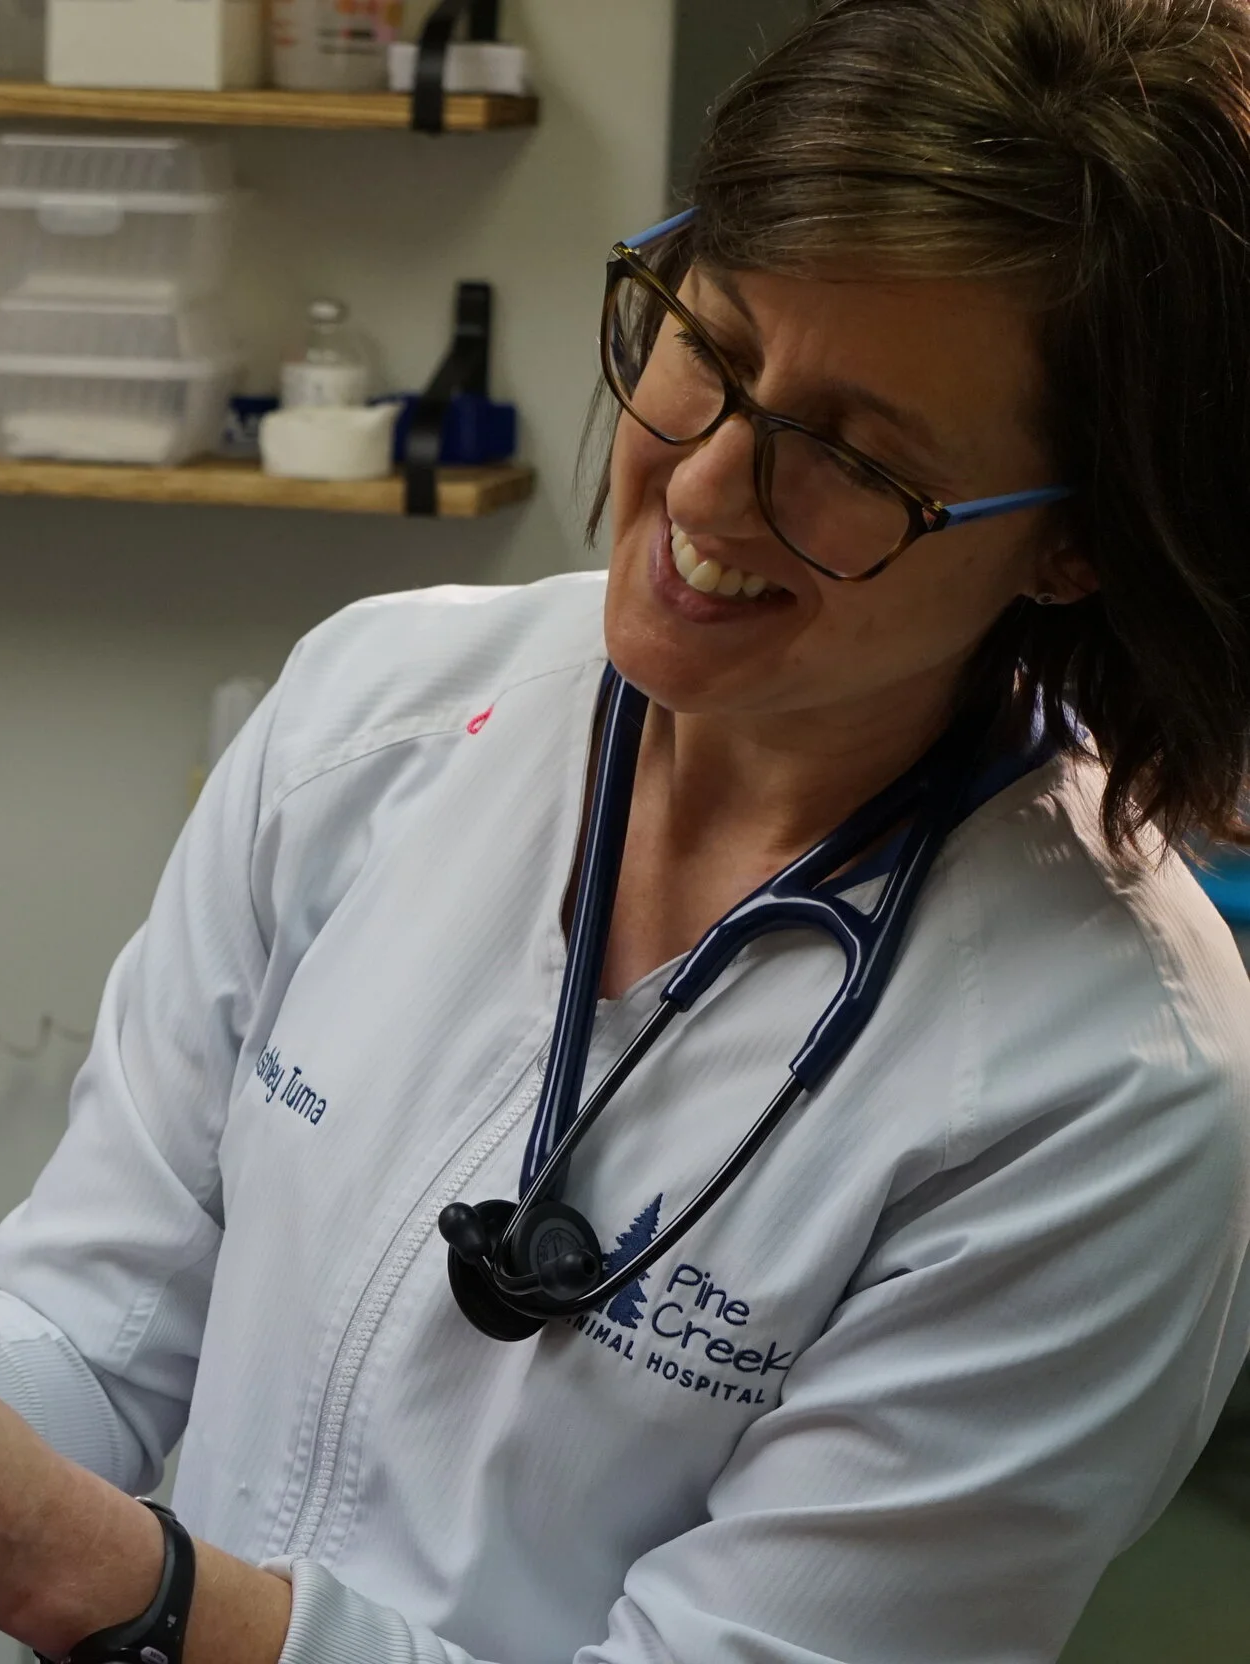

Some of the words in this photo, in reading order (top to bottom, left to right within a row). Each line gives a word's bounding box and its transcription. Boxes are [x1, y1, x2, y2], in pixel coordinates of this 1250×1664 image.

[256, 1044, 285, 1104] shley
[280, 1066, 327, 1125] Tuma
[667, 1264, 750, 1326] Pine
[566, 1315, 635, 1361] NIMAL
[647, 1352, 766, 1404] HOSPITAL
[652, 1302, 792, 1376] Creek
